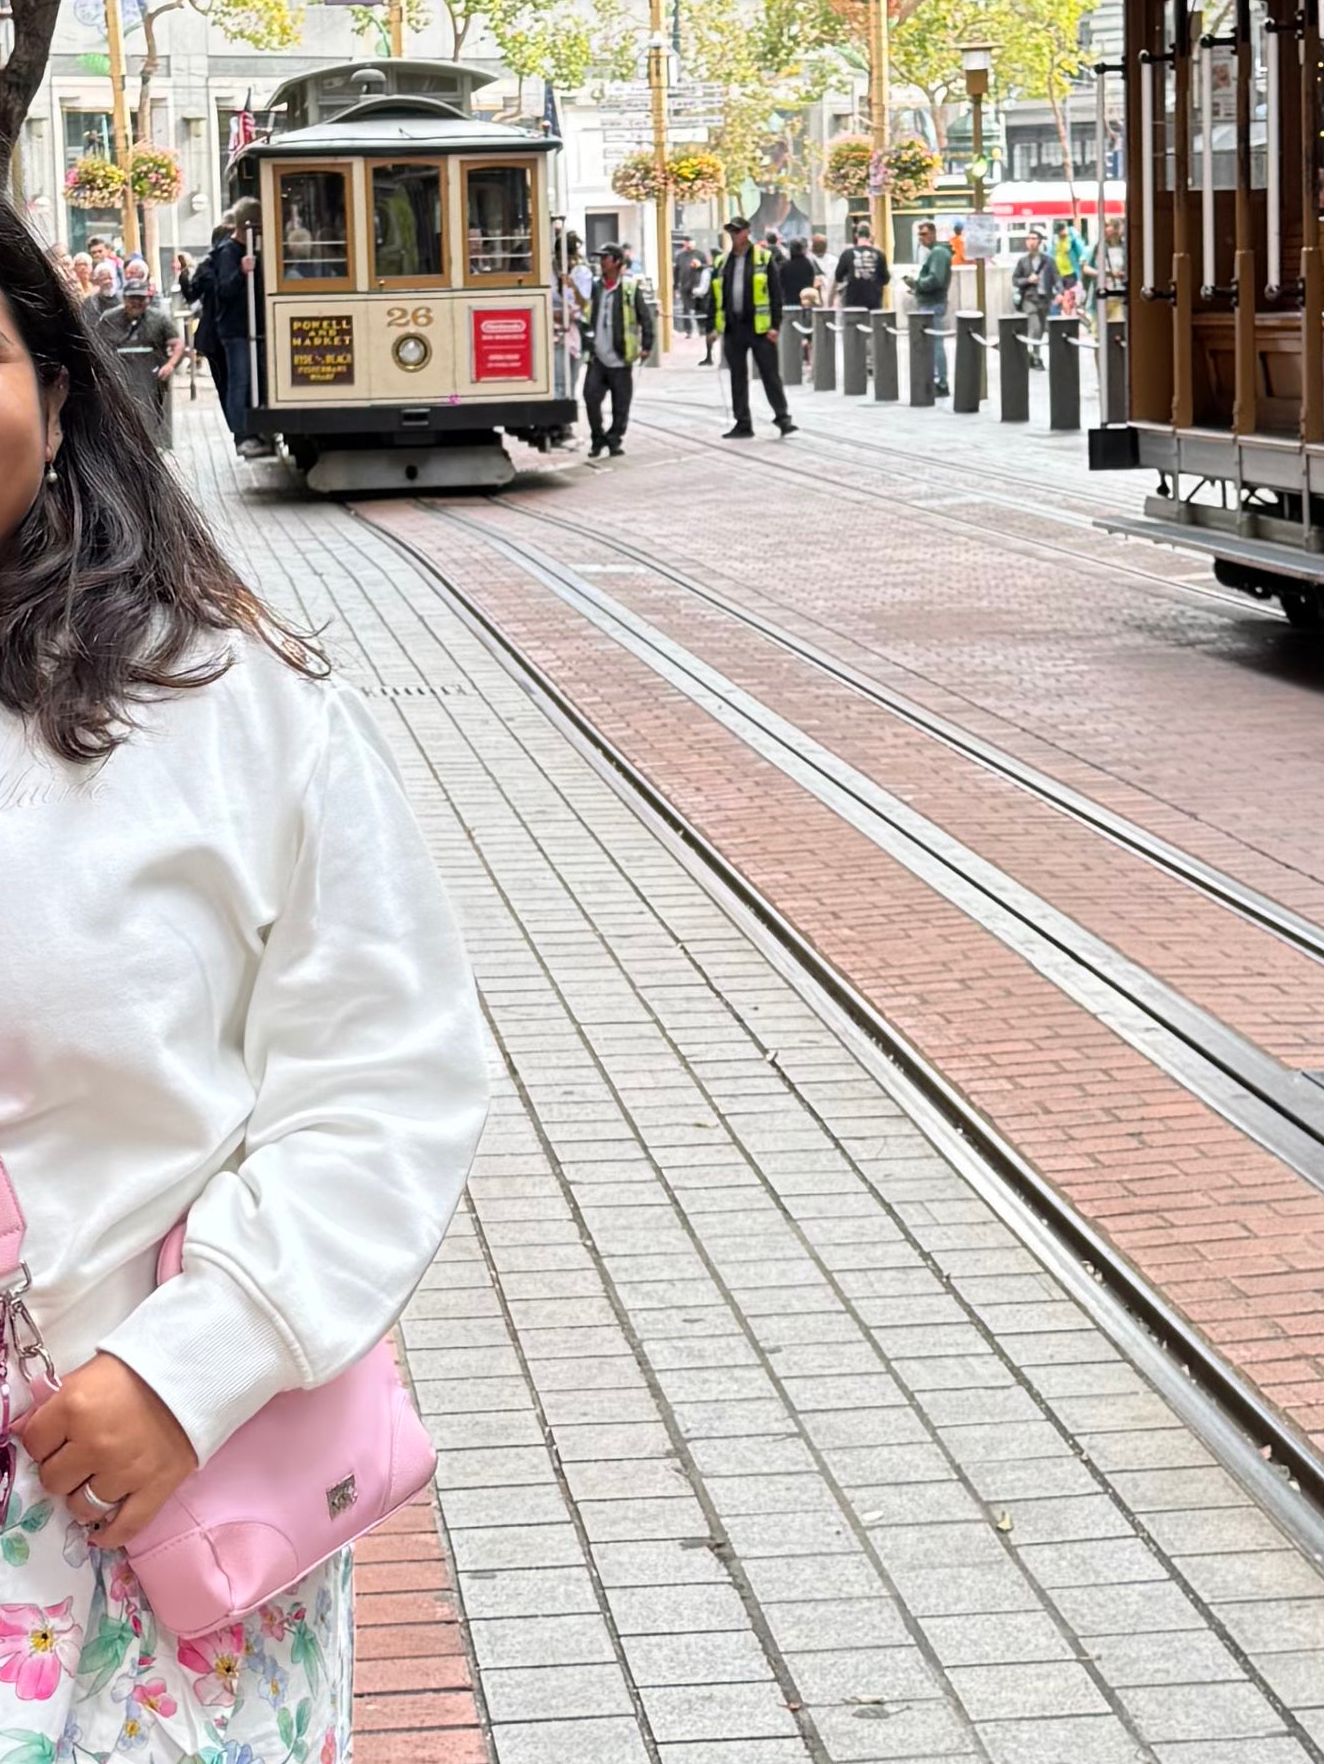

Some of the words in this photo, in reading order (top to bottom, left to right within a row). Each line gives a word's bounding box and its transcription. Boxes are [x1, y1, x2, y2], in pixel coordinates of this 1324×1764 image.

[386, 306, 434, 327] 26
[293, 320, 350, 330] POWELL
[292, 336, 351, 346] MARKET
